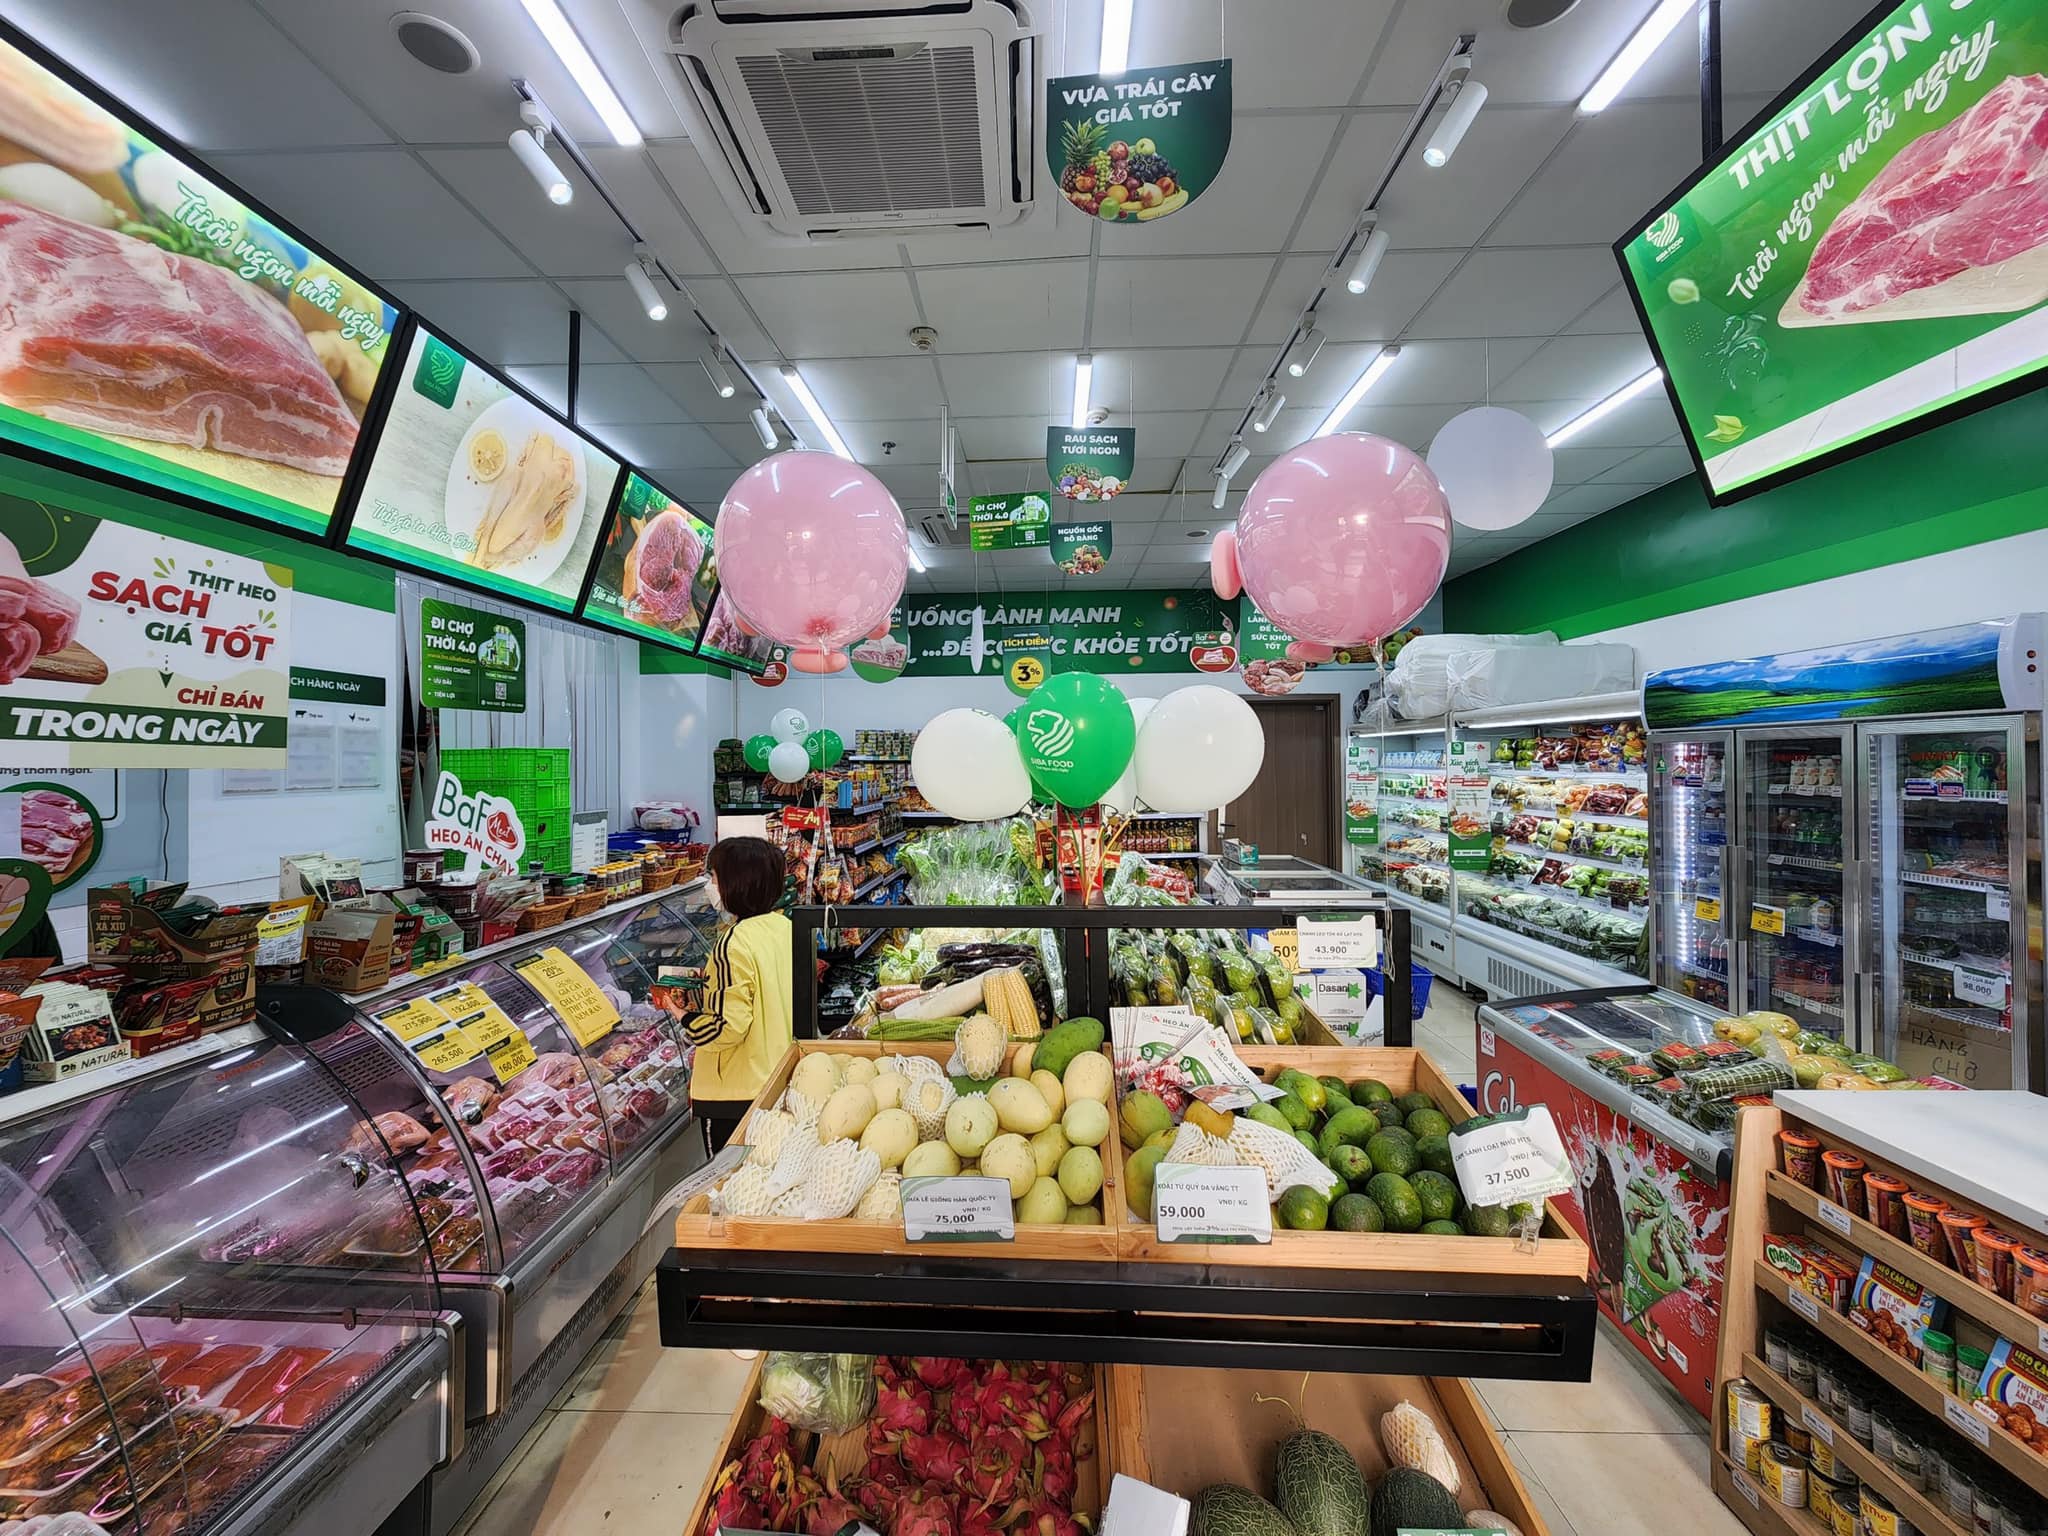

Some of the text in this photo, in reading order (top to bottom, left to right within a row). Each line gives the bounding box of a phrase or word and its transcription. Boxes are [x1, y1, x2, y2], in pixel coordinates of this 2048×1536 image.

[1062, 72, 1217, 107] VỰA TRÁI CÂY
[1728, 3, 1933, 190] THỊT LỢN
[1095, 97, 1182, 124] GIÁ TỐT
[1726, 239, 1778, 300] Tươi
[1776, 171, 1835, 243] ngon
[1838, 95, 1896, 173] mỗi
[1903, 20, 2000, 114] ngày
[232, 239, 296, 281] ngon
[294, 278, 343, 315] mỗi
[336, 305, 386, 351] ngày
[1062, 445, 1121, 455] TƯƠI NGON
[1064, 434, 1118, 446] RAU SẠCH
[975, 501, 1007, 512] ĐI CHỢ
[994, 511, 1009, 520] 4.0
[87, 570, 212, 619] SẠCH
[188, 570, 277, 602] THỊT HEO
[981, 604, 1043, 626] LÀNH
[1049, 606, 1122, 628] MẠNH
[430, 616, 475, 638] ĐI CHỢ
[144, 622, 275, 661] GIÁ TỐT
[424, 633, 477, 653] THỜI 4.0
[1004, 637, 1024, 647] TÍCH
[1025, 635, 1049, 646] ĐIỂM
[1080, 631, 1140, 655] KHỎE
[1145, 631, 1193, 653] TỐT
[1264, 642, 1281, 650] TỐT
[1018, 665, 1041, 681] 3%
[307, 676, 335, 690] HÀNG
[336, 680, 361, 692] NGÀY
[177, 685, 264, 710] CHỈ BÁN
[10, 706, 264, 744] TRONG NGÀY
[1047, 760, 1074, 769] FOOD
[438, 778, 491, 833] BaF
[431, 828, 516, 877] HEO ĂN CHAY
[1178, 1021, 1190, 1029] ĂN
[1912, 1029, 1968, 1056] HÀNG
[80, 1047, 129, 1070] NATURAL
[432, 1047, 465, 1066] 265,500
[1216, 1047, 1228, 1062] HEO
[1485, 1166, 1530, 1186] 37,500
[1211, 1184, 1230, 1192] VÀNG
[935, 1213, 975, 1225] 75,000
[1159, 1205, 1206, 1218] 59,000
[2014, 1349, 2033, 1366] HEO
